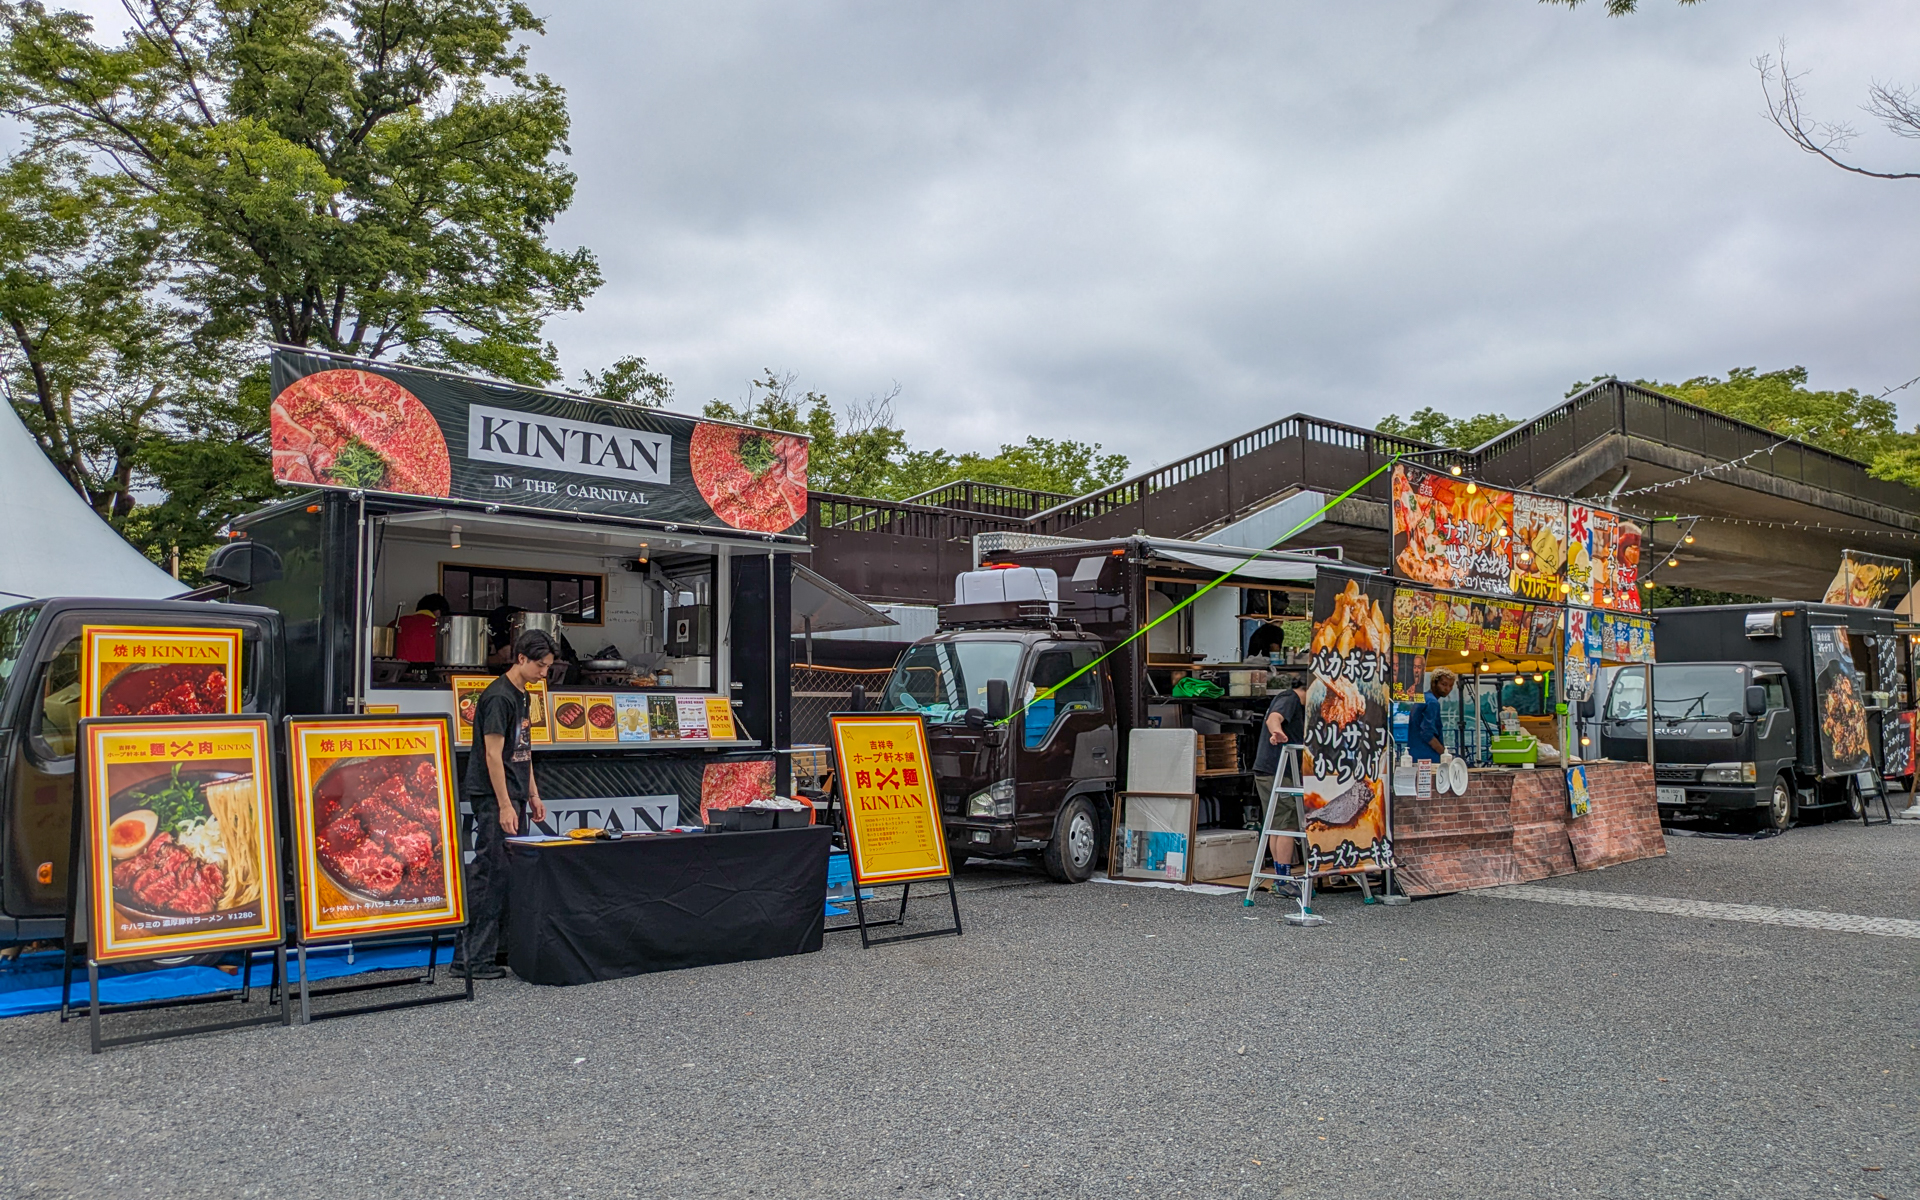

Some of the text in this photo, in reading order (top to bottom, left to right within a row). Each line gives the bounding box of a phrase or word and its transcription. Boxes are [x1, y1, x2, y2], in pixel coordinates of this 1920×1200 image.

[479, 415, 662, 475] KINTAN
[493, 474, 649, 505] IN THE CARNIVAL
[1570, 506, 1588, 543] 氷
[1445, 545, 1510, 579] 世界大会出場
[113, 644, 220, 658] 焼肉 KINTAN
[1309, 650, 1388, 683] バカポテト
[320, 736, 427, 753] 焼肉 KINTAN
[869, 740, 894, 750] 吉祥寺
[1305, 721, 1387, 751] バルサミコ
[198, 741, 213, 755] 肉
[217, 743, 252, 751] KINTAN
[853, 752, 916, 764] ホープ軒本舗
[1314, 749, 1382, 783] からあげ
[855, 769, 872, 789] 肉
[1438, 771, 1444, 784] S
[1452, 770, 1461, 784] M
[859, 793, 924, 811] KINTAN
[1308, 841, 1394, 871] チーズケーキ串
[322, 903, 363, 914] レッドホット
[364, 900, 391, 910] 牛ハラミ
[393, 897, 419, 907] ステーキ
[120, 911, 257, 932] 牛ハラミの 濃厚豚骨ラーメン ¥1280-
